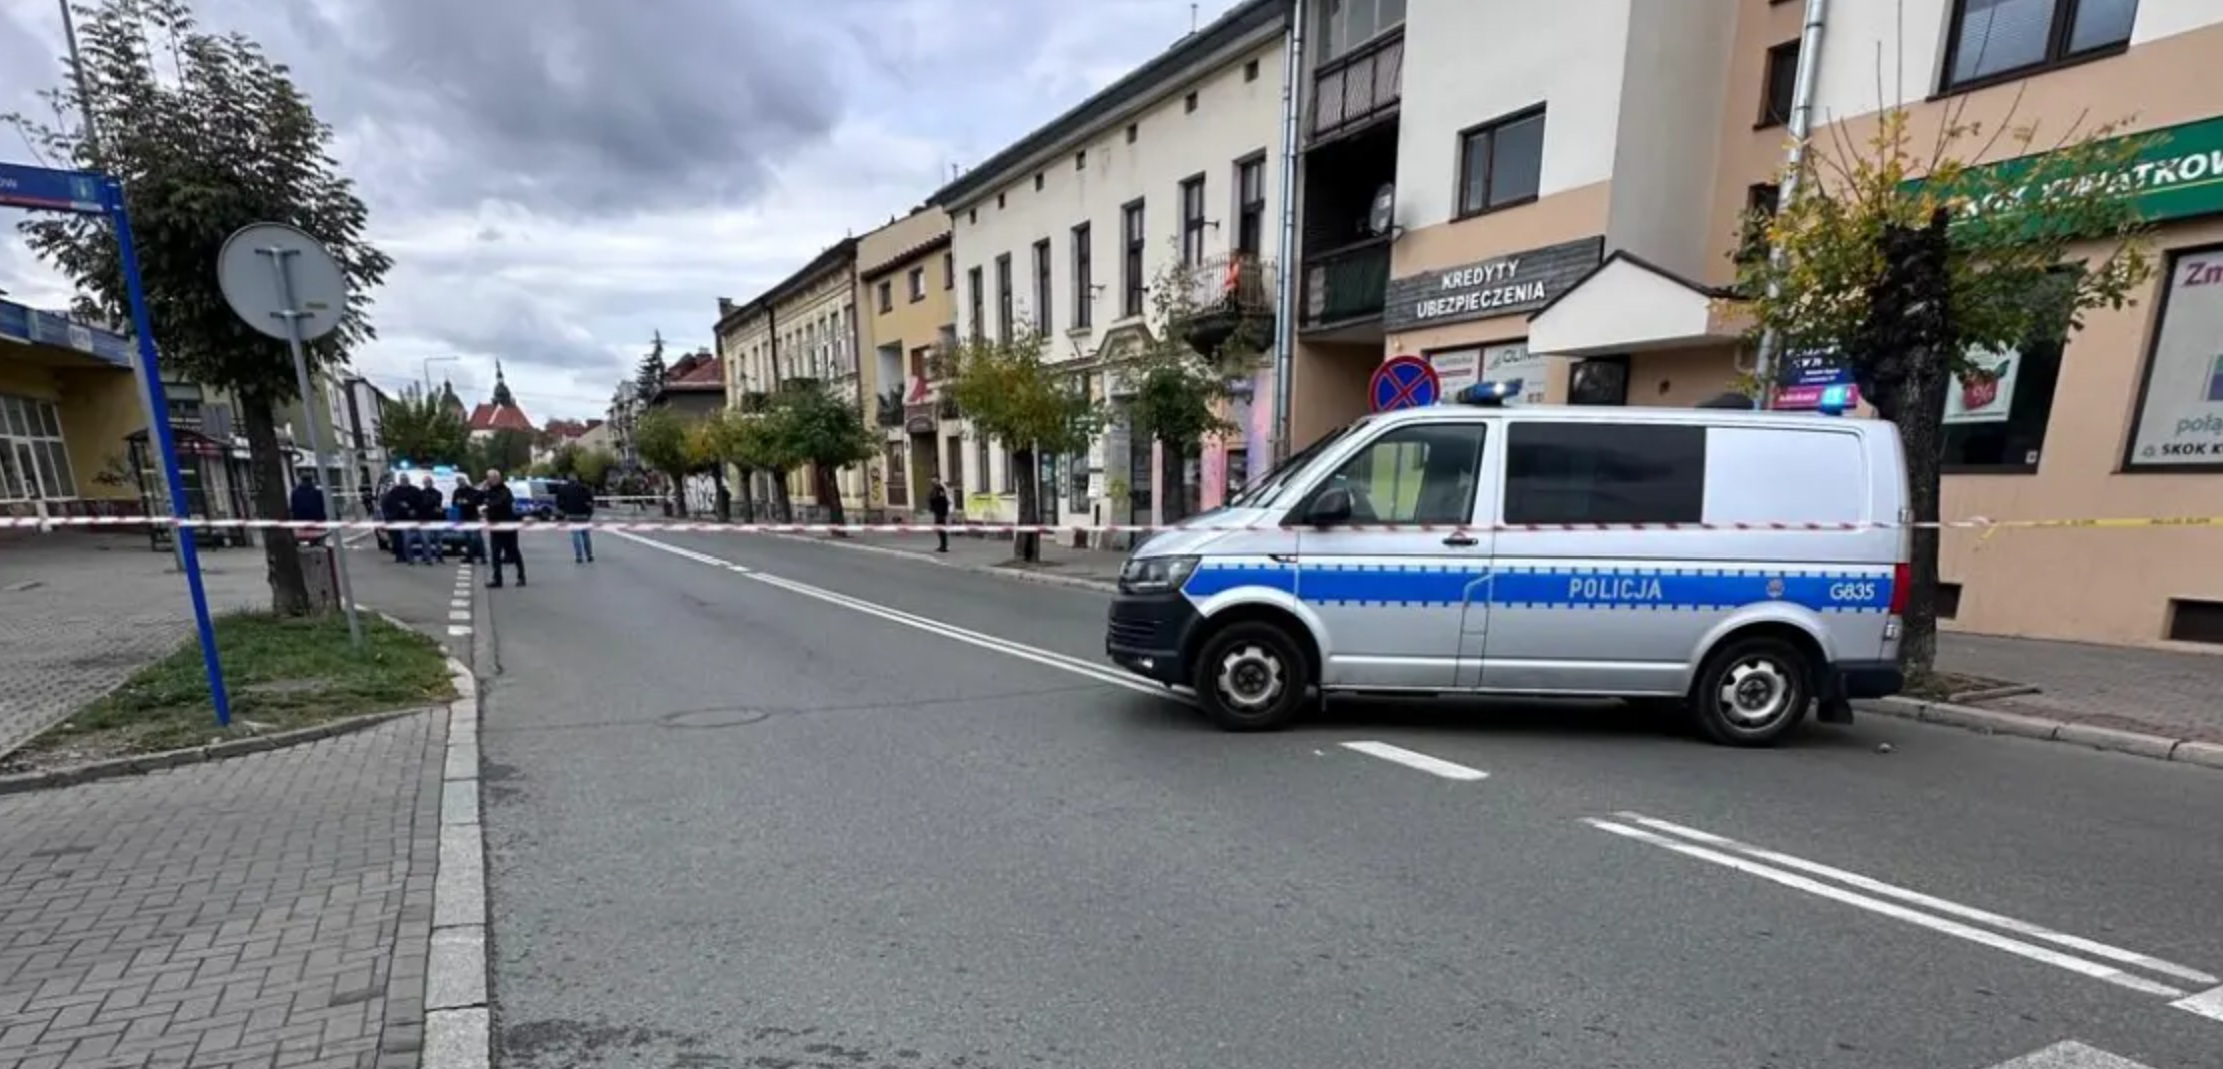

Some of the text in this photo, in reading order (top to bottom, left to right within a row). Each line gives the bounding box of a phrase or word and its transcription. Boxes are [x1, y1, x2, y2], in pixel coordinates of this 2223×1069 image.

[1442, 259, 1519, 290] KREDYTY
[1417, 281, 1545, 318] UBEZPIECZENIA
[2161, 443, 2206, 456] SKOK
[1568, 578, 1662, 599] POLICJA
[1829, 582, 1875, 600] G835
